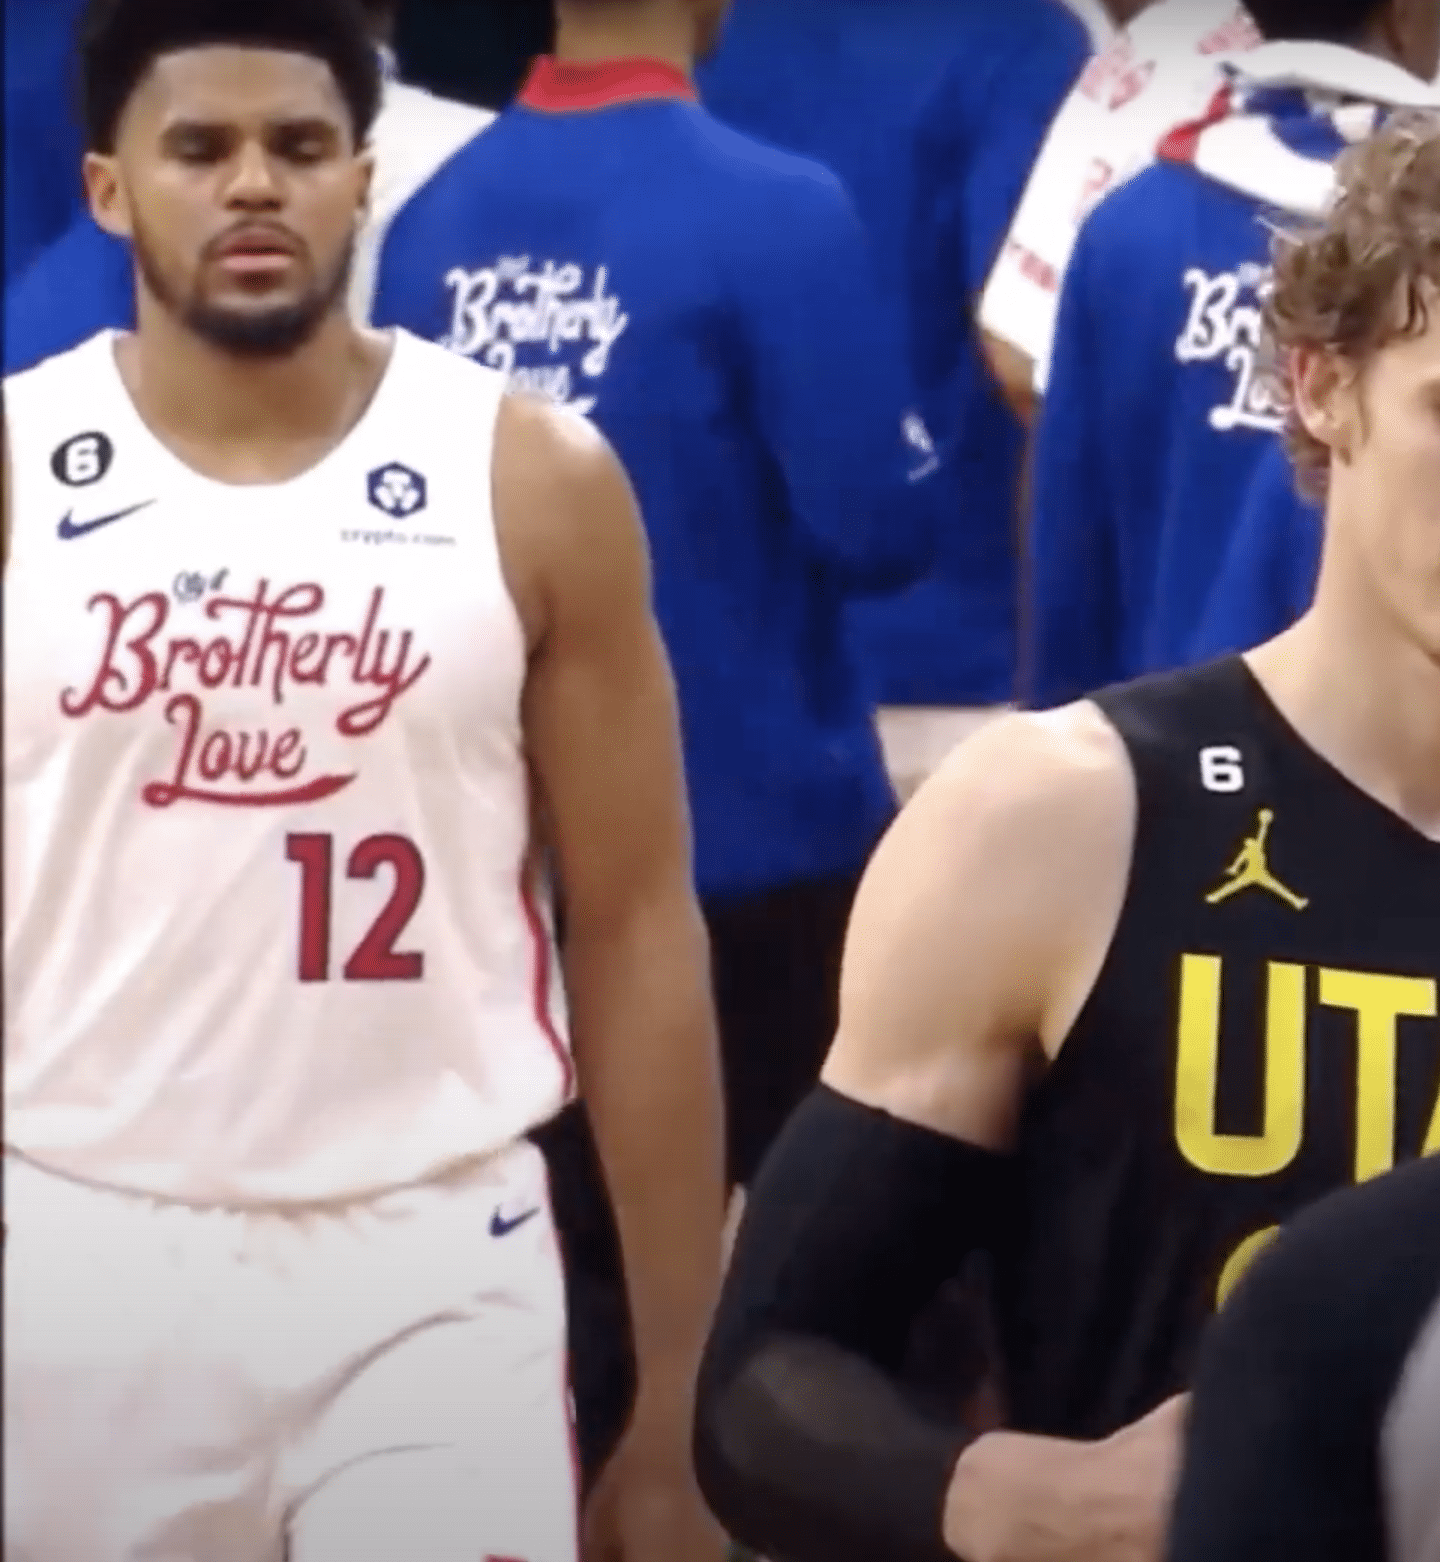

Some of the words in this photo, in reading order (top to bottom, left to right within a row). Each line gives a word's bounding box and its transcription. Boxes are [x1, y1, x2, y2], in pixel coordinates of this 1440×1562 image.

[65, 438, 99, 482] 6
[59, 578, 432, 737] Brotherly
[141, 693, 359, 807] Love
[1199, 745, 1245, 793] 6
[285, 832, 426, 983] 12
